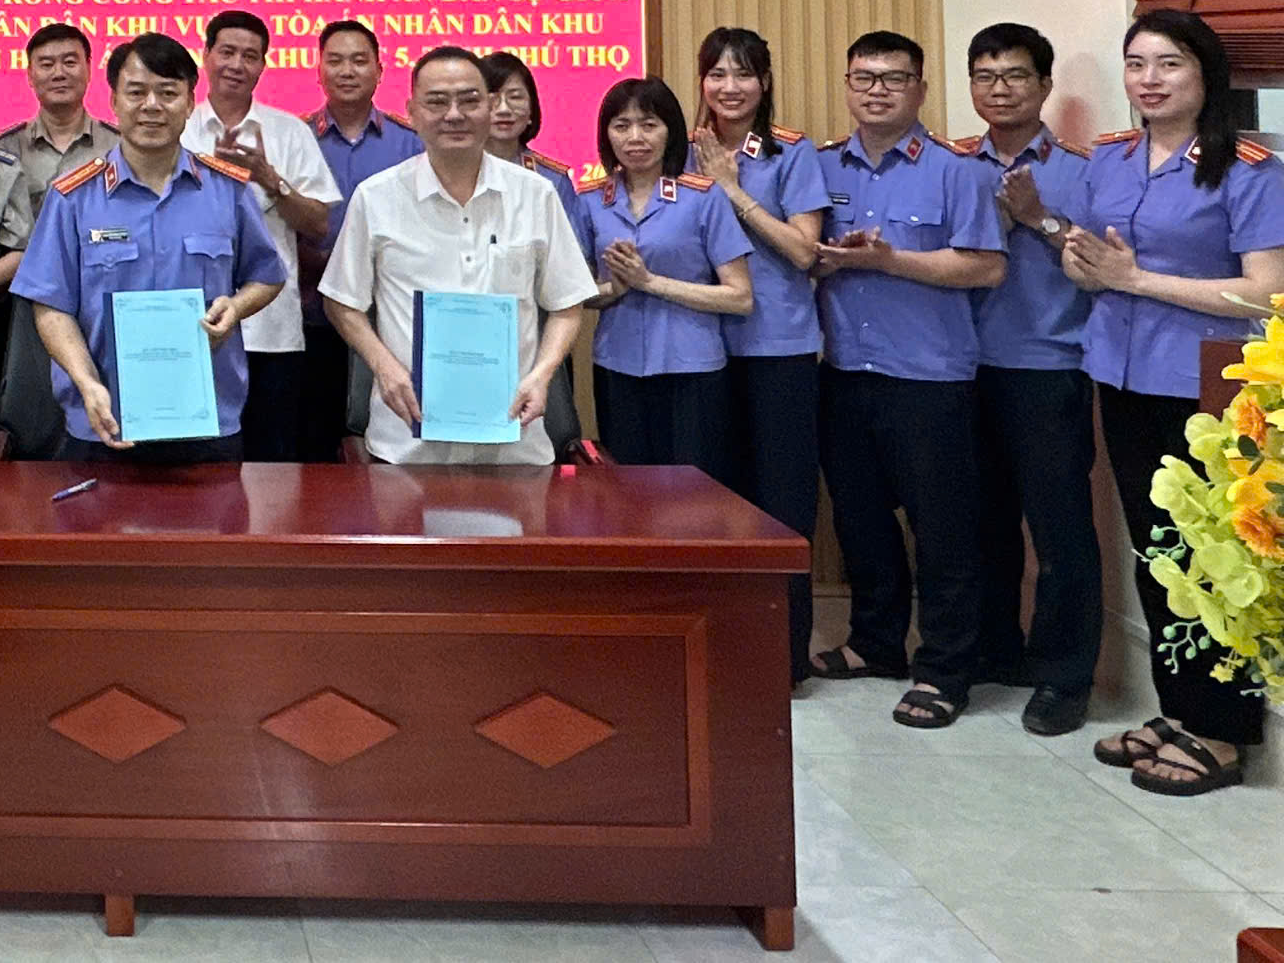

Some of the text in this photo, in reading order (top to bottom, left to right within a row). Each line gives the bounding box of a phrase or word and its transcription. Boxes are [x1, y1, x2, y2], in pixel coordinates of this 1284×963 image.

[105, 16, 167, 37] KHU
[384, 8, 464, 35] NHÂN
[473, 7, 532, 34] DÂN
[541, 13, 604, 35] KHU
[566, 44, 630, 72] THỌ
